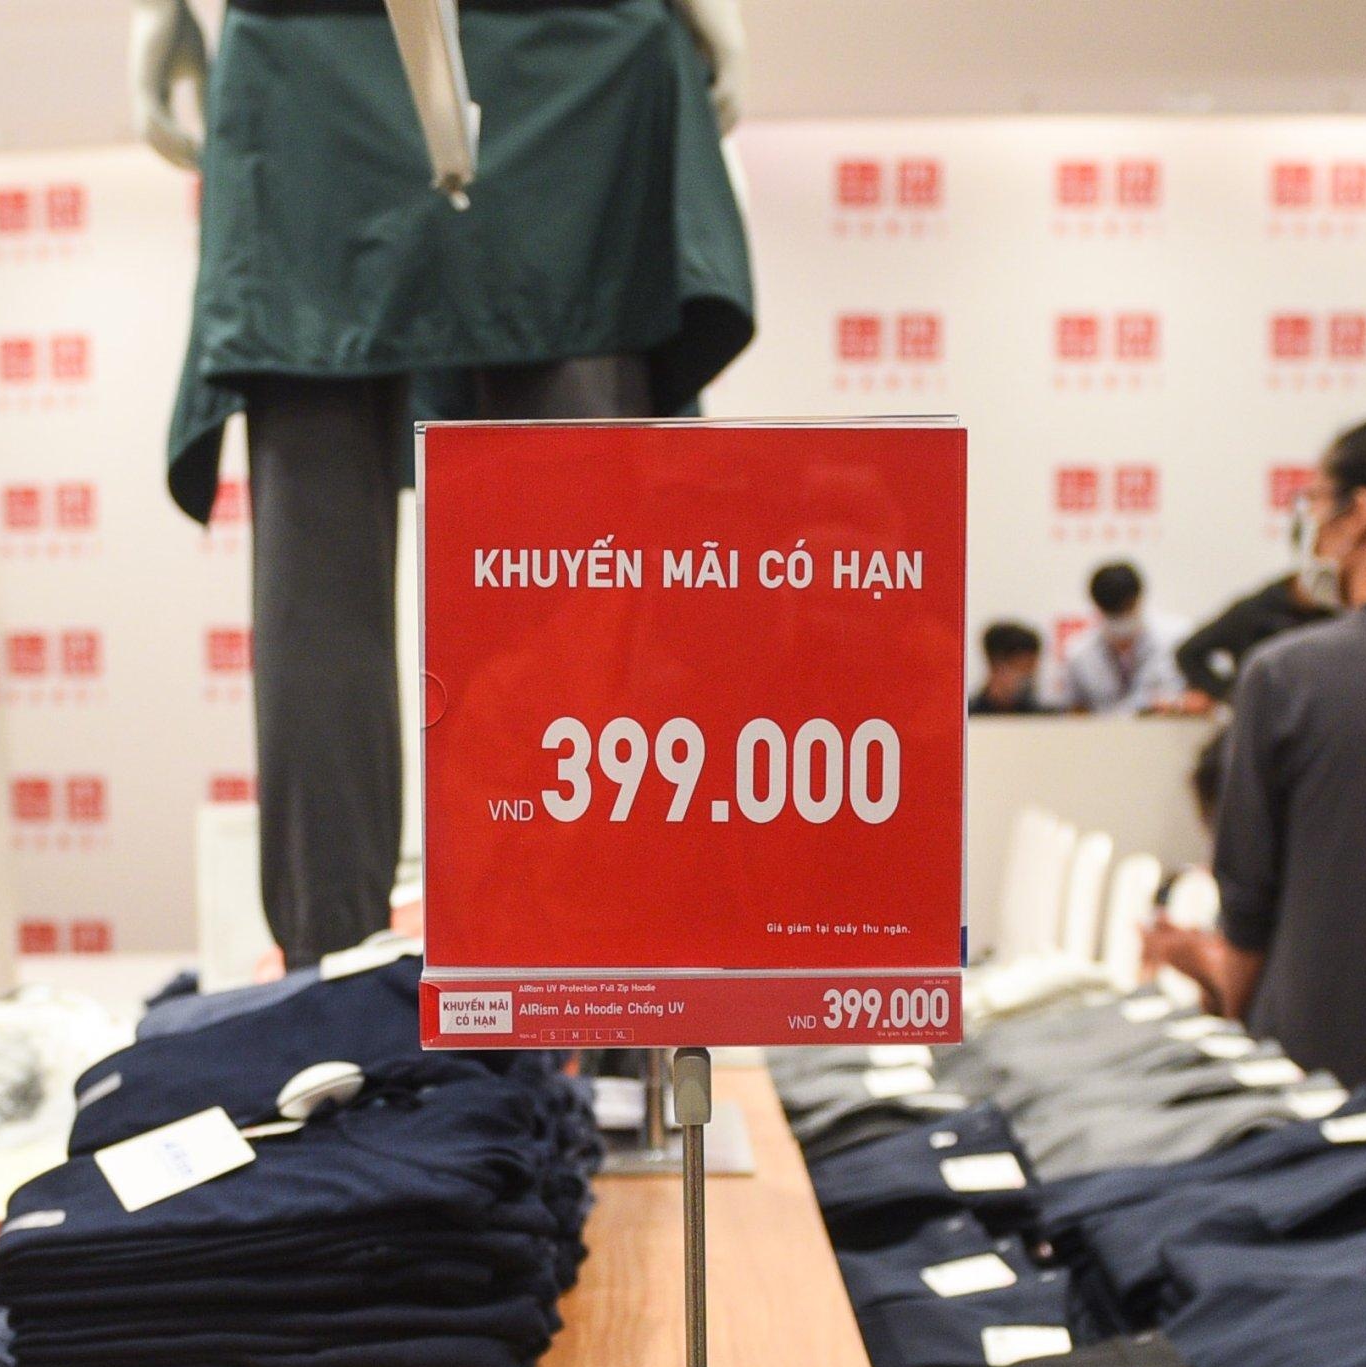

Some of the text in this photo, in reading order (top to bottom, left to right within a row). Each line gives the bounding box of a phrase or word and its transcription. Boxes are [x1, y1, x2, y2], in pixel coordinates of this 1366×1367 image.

[474, 534, 923, 600] KHUYẾN MÃI CÓ HẠN
[488, 716, 901, 824] VND 399.000
[863, 922, 879, 934] thu
[546, 984, 557, 993] UV
[560, 984, 597, 993] Protection
[617, 983, 629, 994] Zip
[632, 983, 655, 992] Hoodie
[443, 997, 485, 1011] KHUYẾN
[518, 1000, 685, 1017] AIRism Áo Hoodie Chống UV
[787, 987, 950, 1029] VND 399.000
[456, 1013, 496, 1028] CÓ HẠN
[550, 1031, 556, 1040] S
[572, 1031, 579, 1039] M
[616, 1031, 626, 1039] XL
